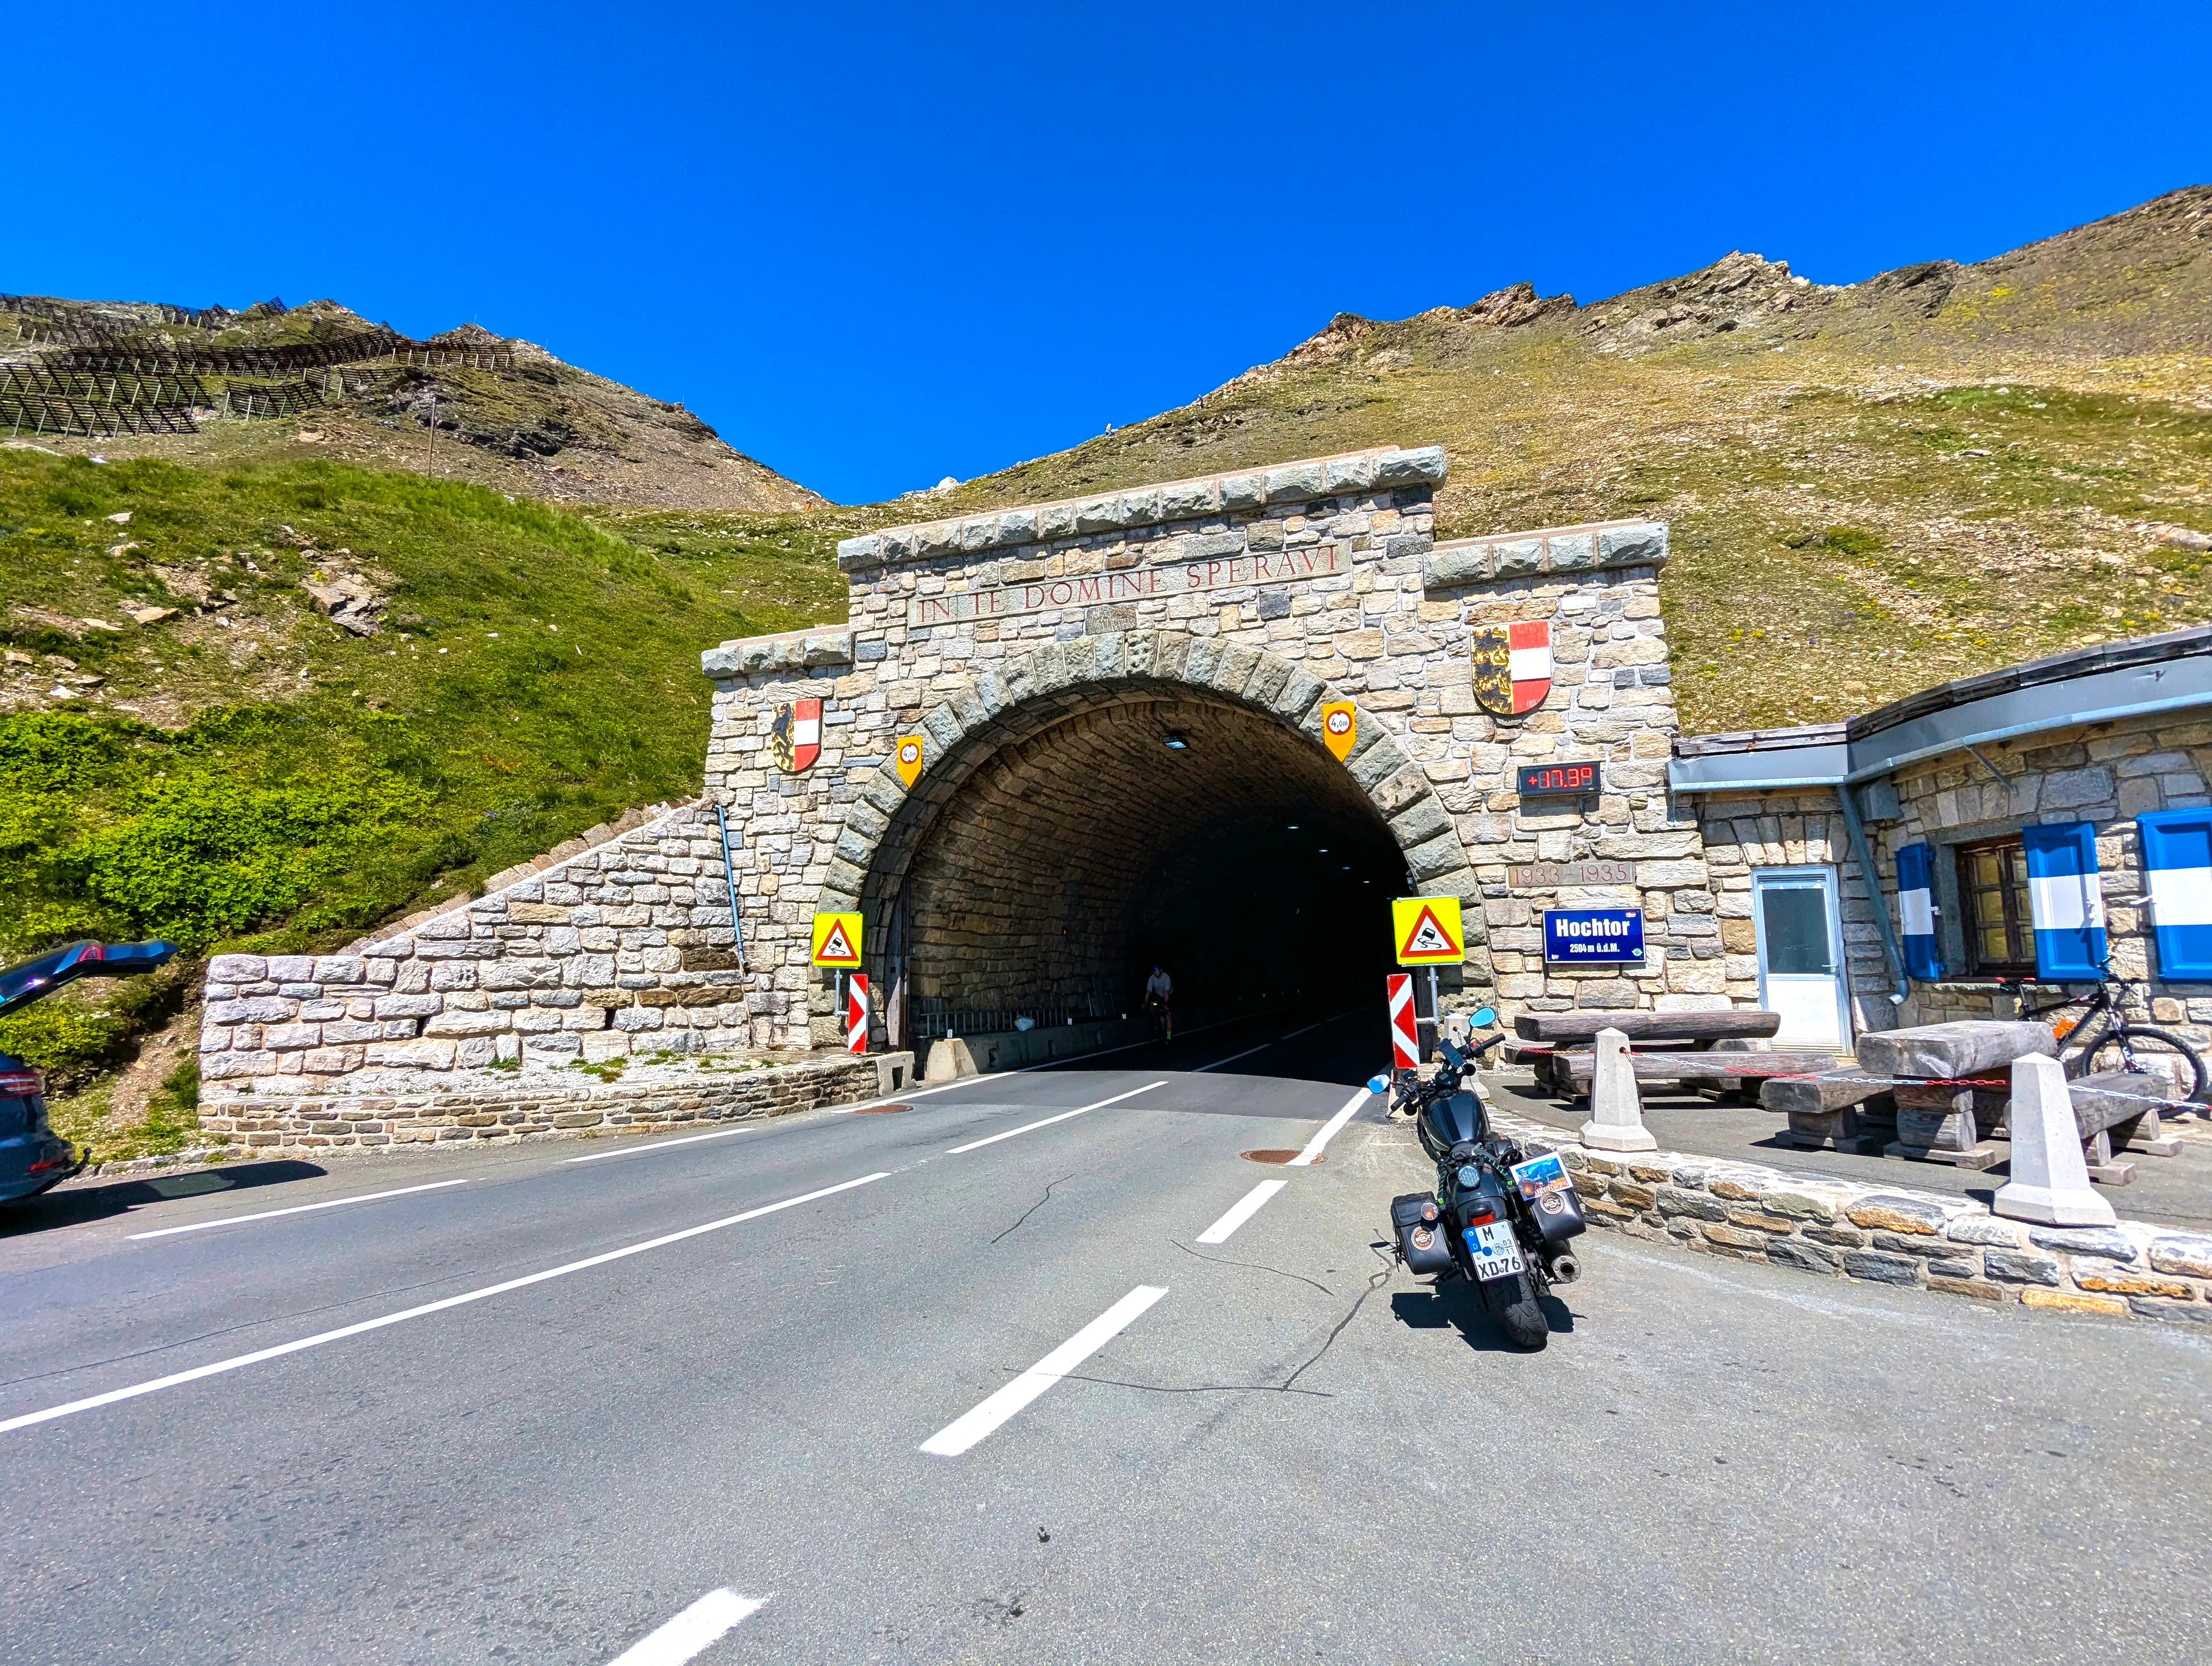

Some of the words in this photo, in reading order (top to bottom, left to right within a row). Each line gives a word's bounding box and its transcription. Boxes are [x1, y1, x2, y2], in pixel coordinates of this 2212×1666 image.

[918, 599, 950, 623] IN
[969, 592, 1006, 615] TE
[1024, 569, 1168, 609] DOMINE
[1186, 544, 1339, 588] SPERAVI
[1331, 717, 1348, 728] 4,0m
[903, 749, 916, 758] 4,0m
[1514, 867, 1560, 885] 1933
[1579, 864, 1626, 882] 1935
[1555, 918, 1630, 937] Hochtor
[1570, 944, 1587, 953] 2504
[1482, 1226, 1494, 1241] M
